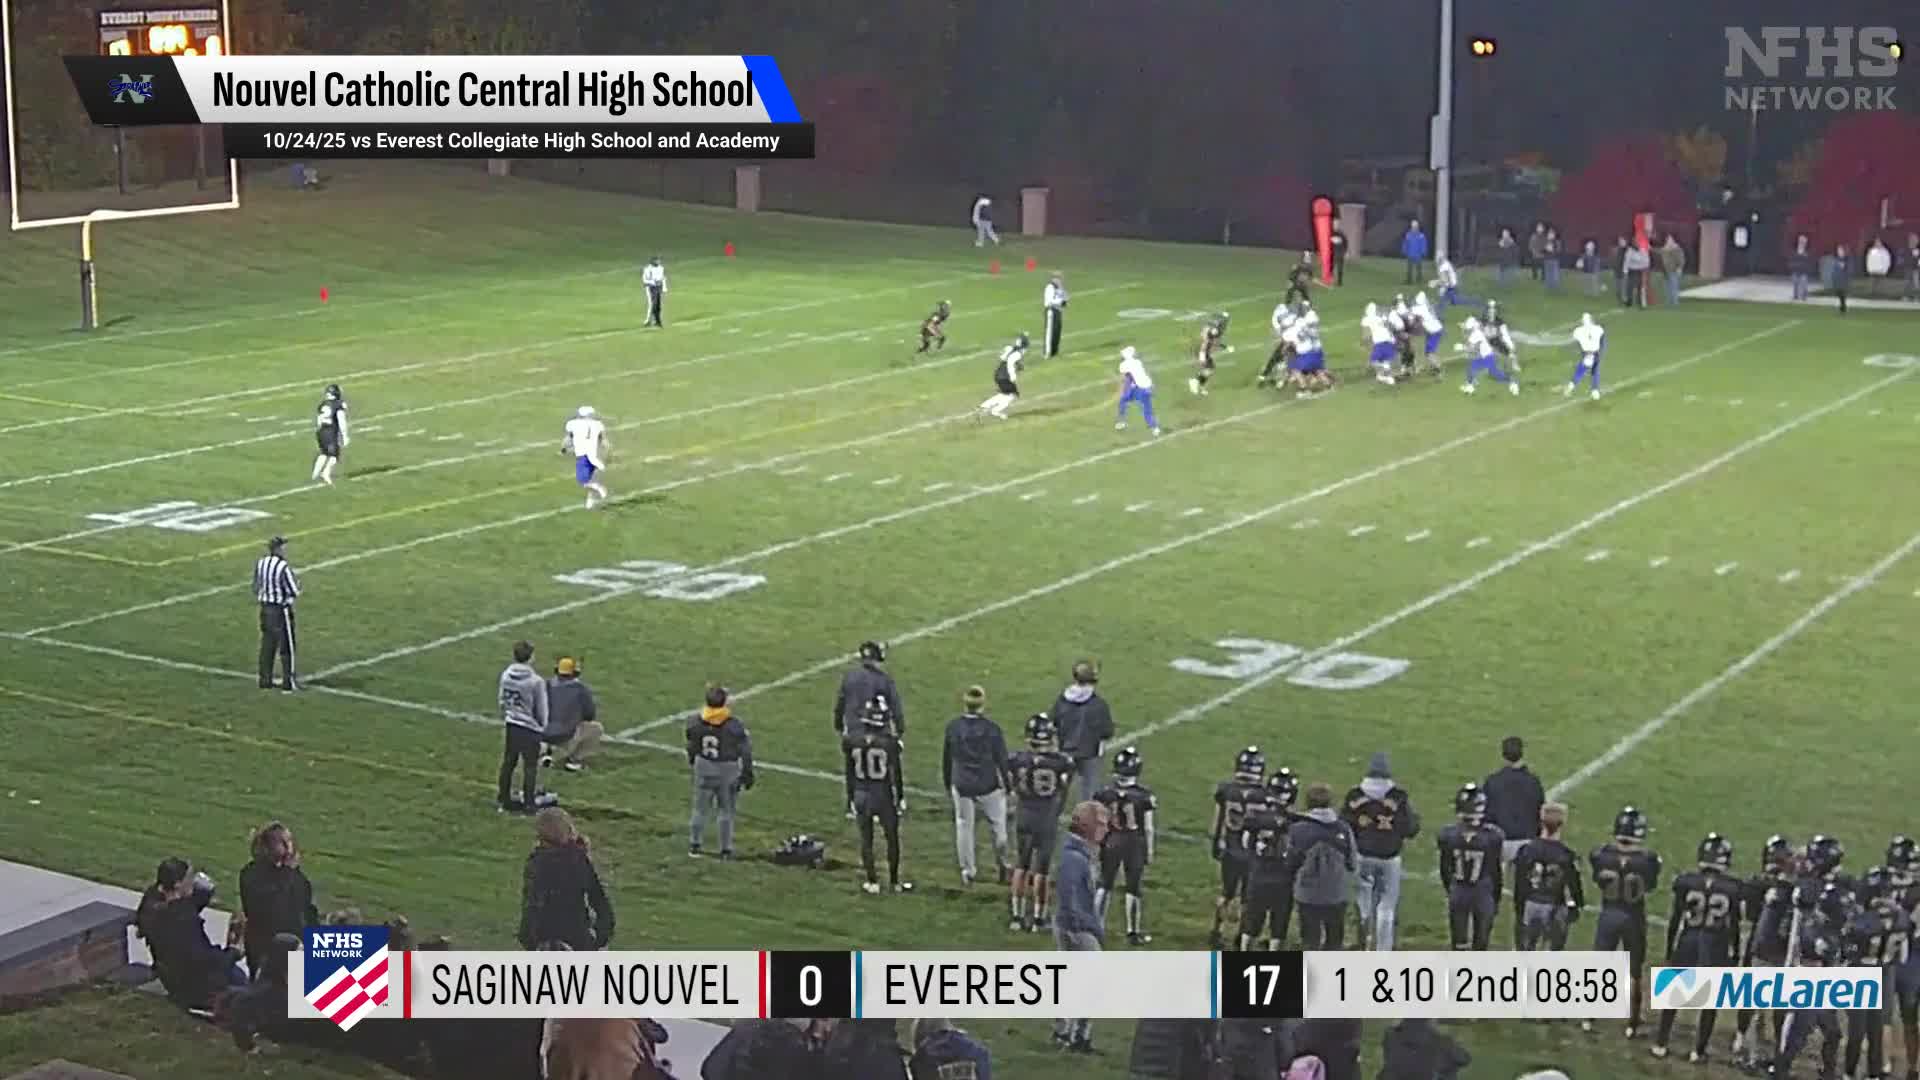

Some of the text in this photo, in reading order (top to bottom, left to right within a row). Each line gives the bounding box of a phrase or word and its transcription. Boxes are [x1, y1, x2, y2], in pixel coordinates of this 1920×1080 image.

[1168, 638, 1412, 690] 30
[851, 747, 888, 780] 10
[1453, 848, 1485, 882] 17
[1685, 890, 1730, 928] 32
